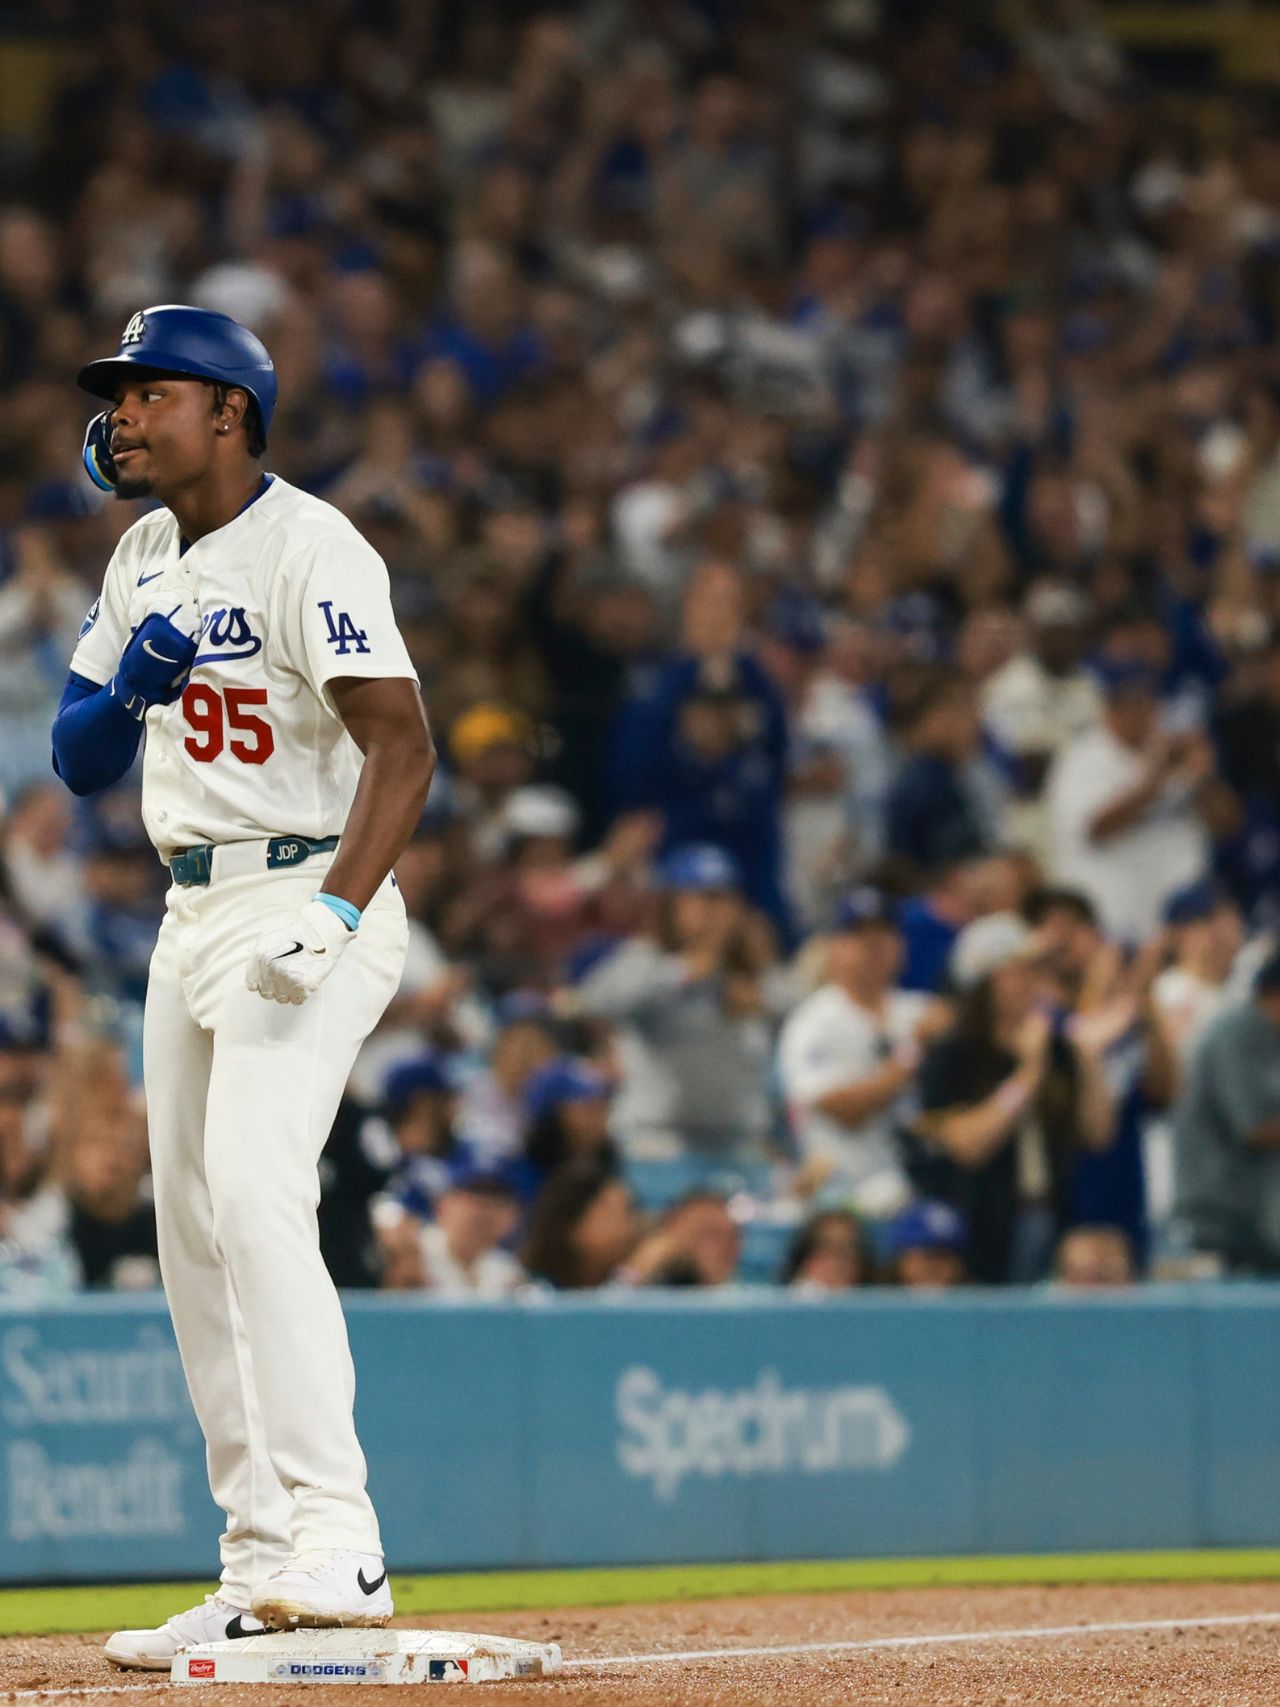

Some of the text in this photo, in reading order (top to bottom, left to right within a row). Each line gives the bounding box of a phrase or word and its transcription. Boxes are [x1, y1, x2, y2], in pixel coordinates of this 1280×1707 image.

[121, 310, 145, 345] LA
[317, 600, 371, 655] LA
[182, 683, 275, 765] 95
[276, 843, 298, 861] JDP
[616, 1367, 908, 1499] Spectrum
[8, 1437, 187, 1541] Benefit
[290, 1664, 367, 1676] DODGERS
